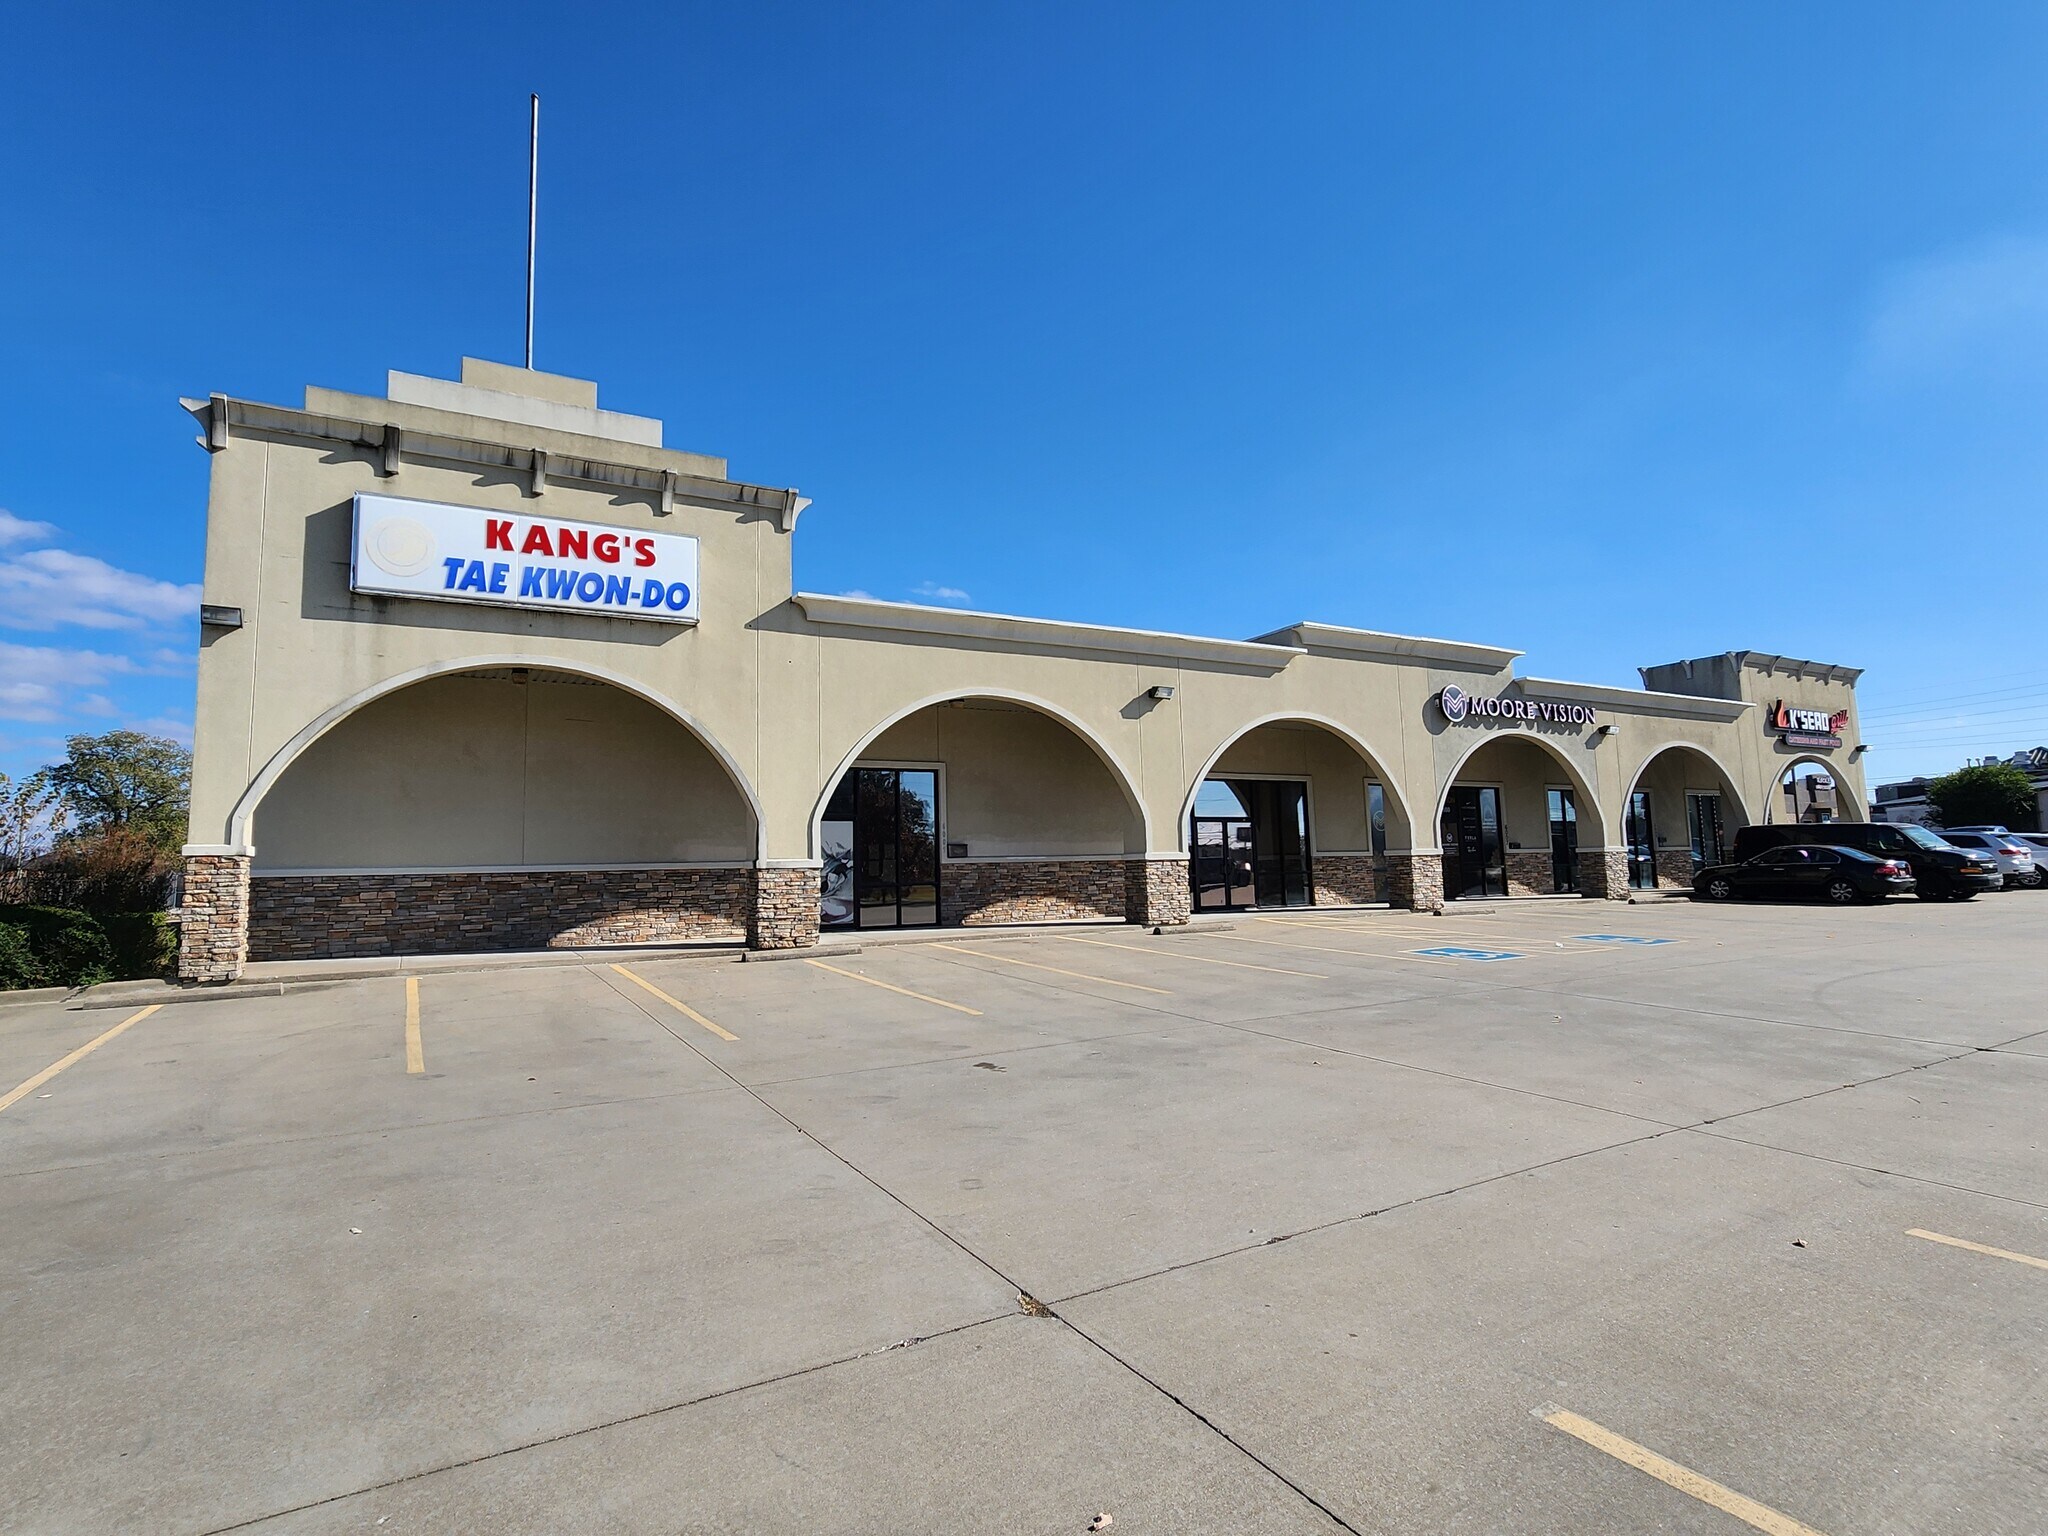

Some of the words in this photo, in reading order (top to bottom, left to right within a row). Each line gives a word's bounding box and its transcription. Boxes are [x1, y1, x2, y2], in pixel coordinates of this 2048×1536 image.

[485, 518, 656, 567] KANG'S
[442, 557, 511, 593] TAE
[520, 566, 691, 611] KWON-DO
[1470, 698, 1536, 720] MOORE
[1538, 702, 1596, 724] VISION
